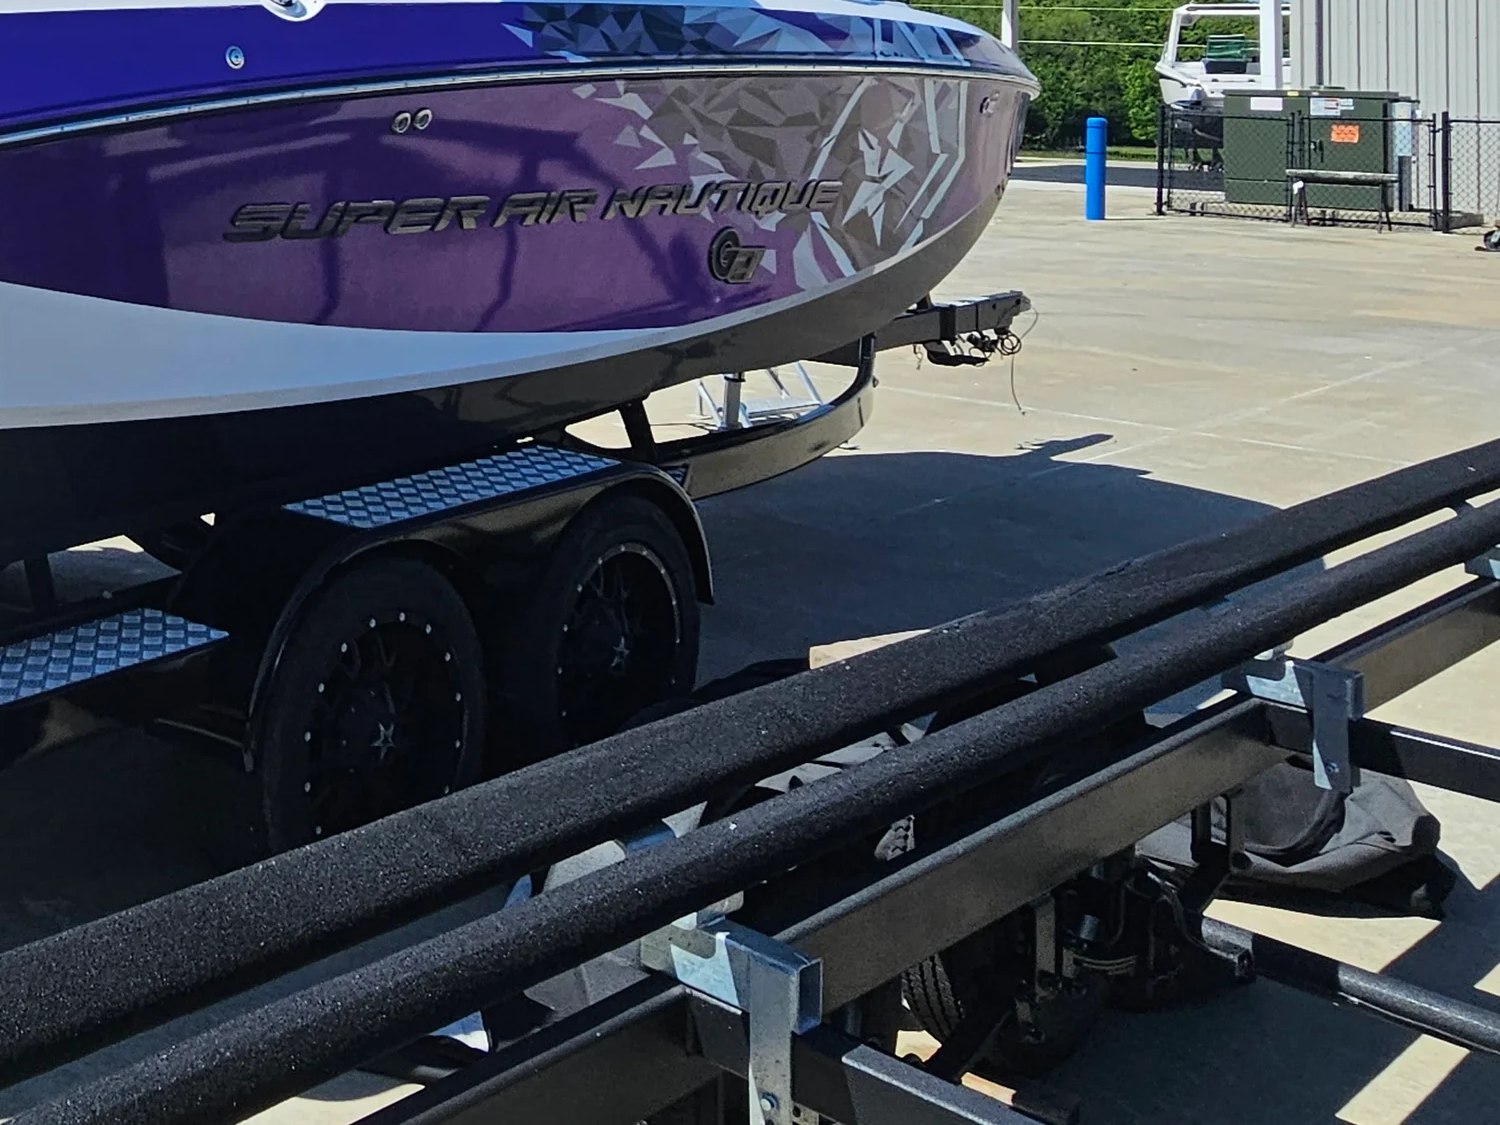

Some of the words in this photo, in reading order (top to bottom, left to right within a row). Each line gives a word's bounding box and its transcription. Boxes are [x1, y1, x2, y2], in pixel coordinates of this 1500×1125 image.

[222, 194, 491, 242] SUPER
[493, 188, 597, 227] AIR
[600, 179, 843, 220] NAUTIQUE
